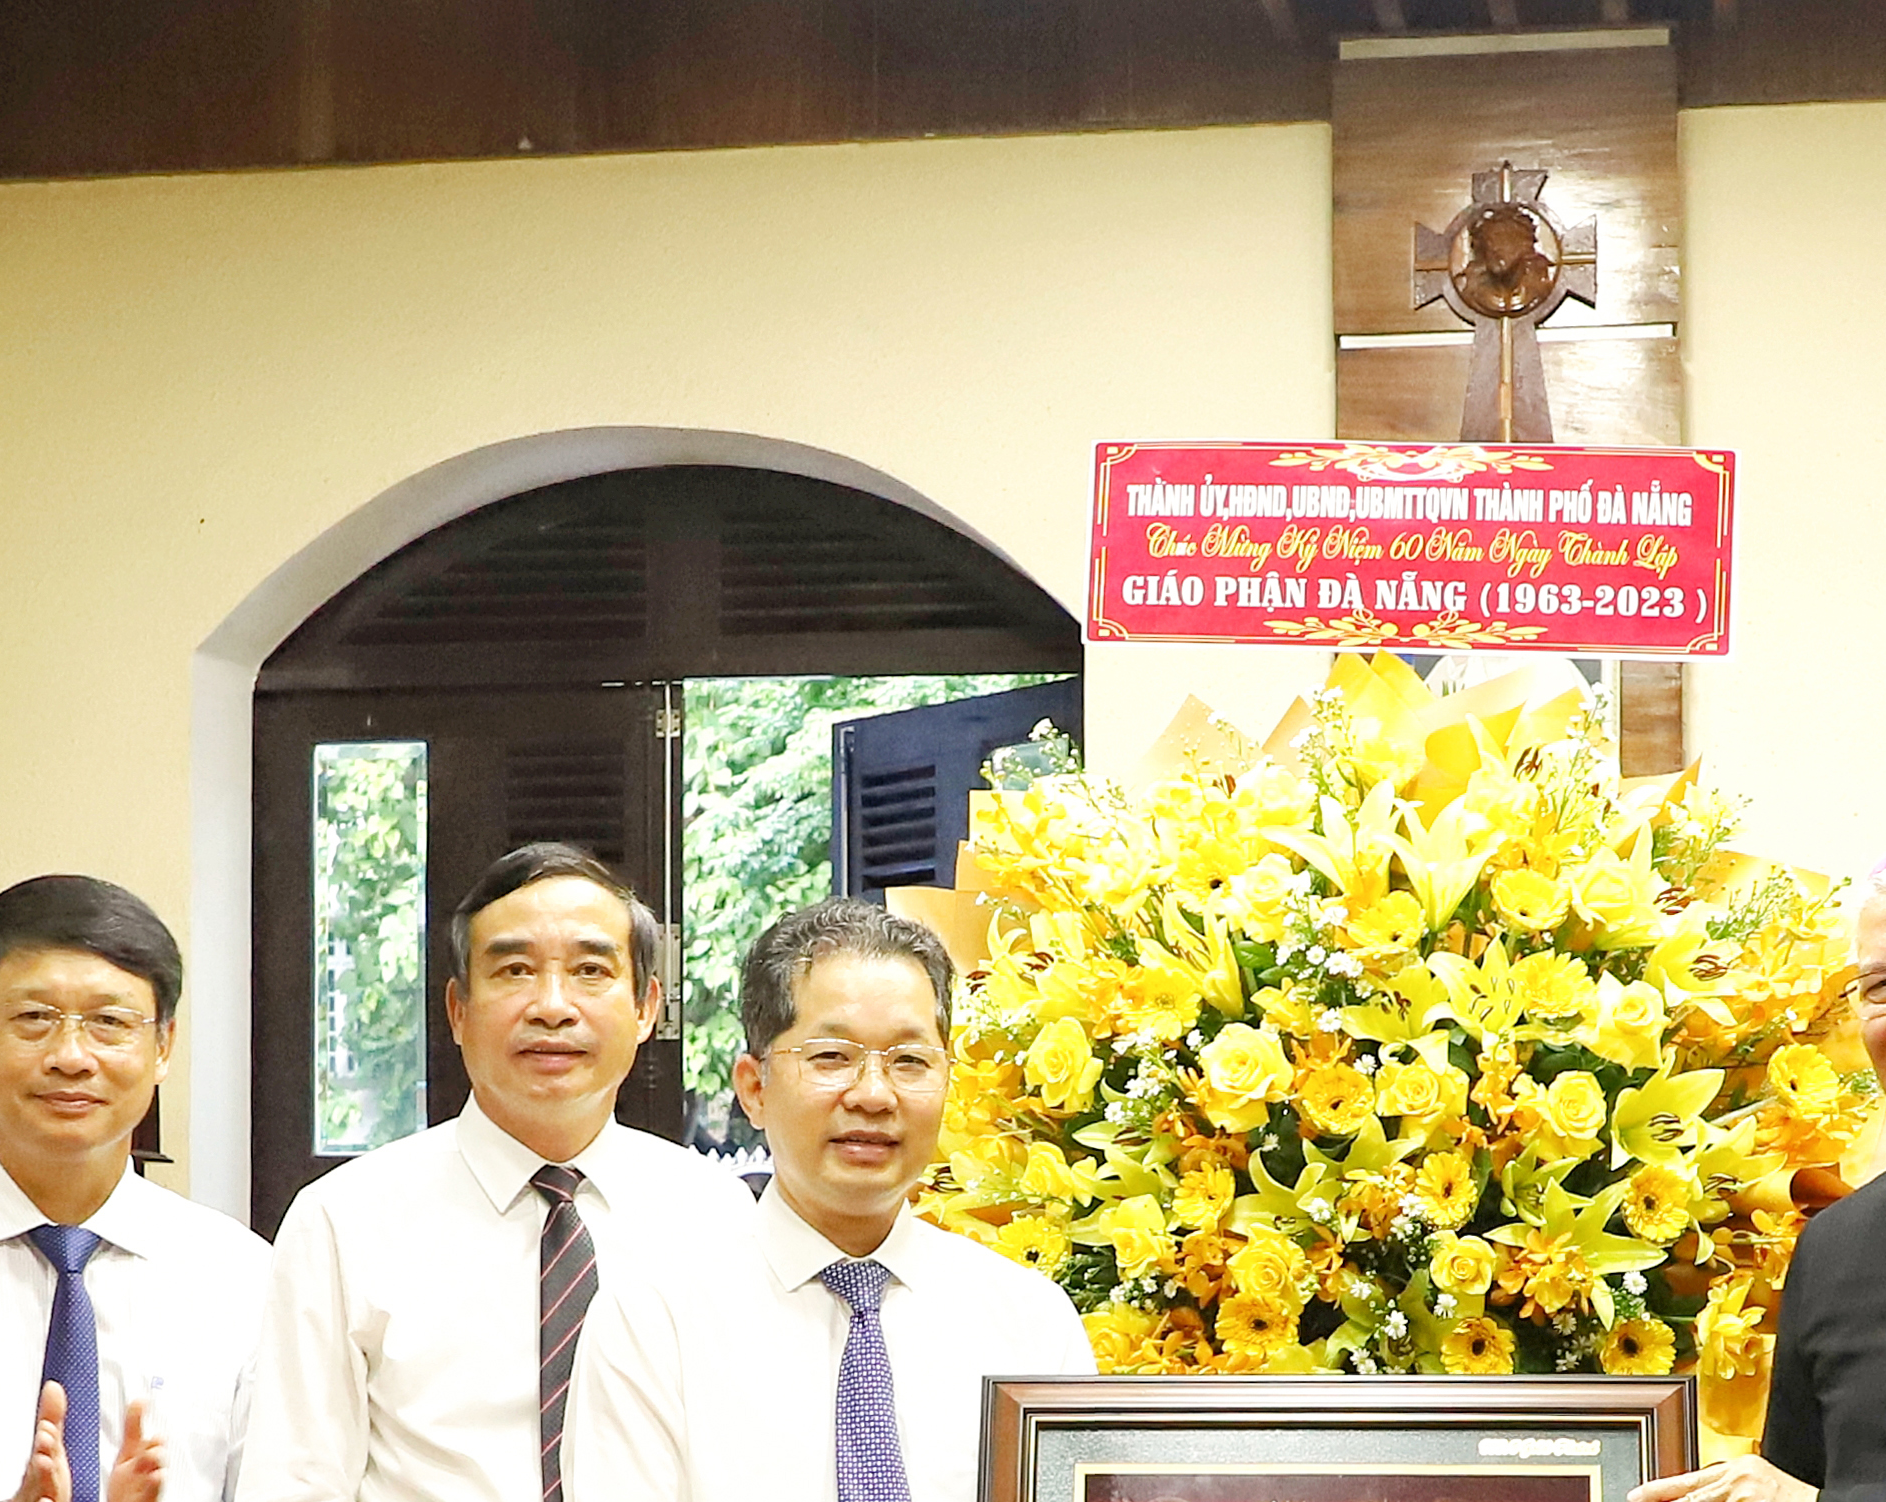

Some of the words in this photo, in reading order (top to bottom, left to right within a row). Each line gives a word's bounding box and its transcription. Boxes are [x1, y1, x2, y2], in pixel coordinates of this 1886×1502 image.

[1126, 477, 1196, 518] THÀNH
[1473, 482, 1545, 522] THÀNH
[1548, 478, 1594, 524] PHỐ
[1596, 484, 1627, 524] ĐÀ
[1631, 480, 1693, 527] NẴNG
[1146, 522, 1198, 558] Chúc
[1201, 523, 1273, 572] Mừng
[1276, 524, 1321, 573] Kỷ
[1322, 525, 1384, 566] Niệm
[1389, 531, 1424, 562] 60
[1425, 526, 1485, 562] Năm
[1488, 528, 1553, 579] Ngày
[1558, 530, 1630, 566] Thành
[1632, 534, 1680, 580] Lập
[1122, 569, 1205, 606] GIÁO
[1213, 571, 1308, 612] PHẬN
[1317, 572, 1364, 609] ĐÀ
[1374, 571, 1468, 613] NẴNG
